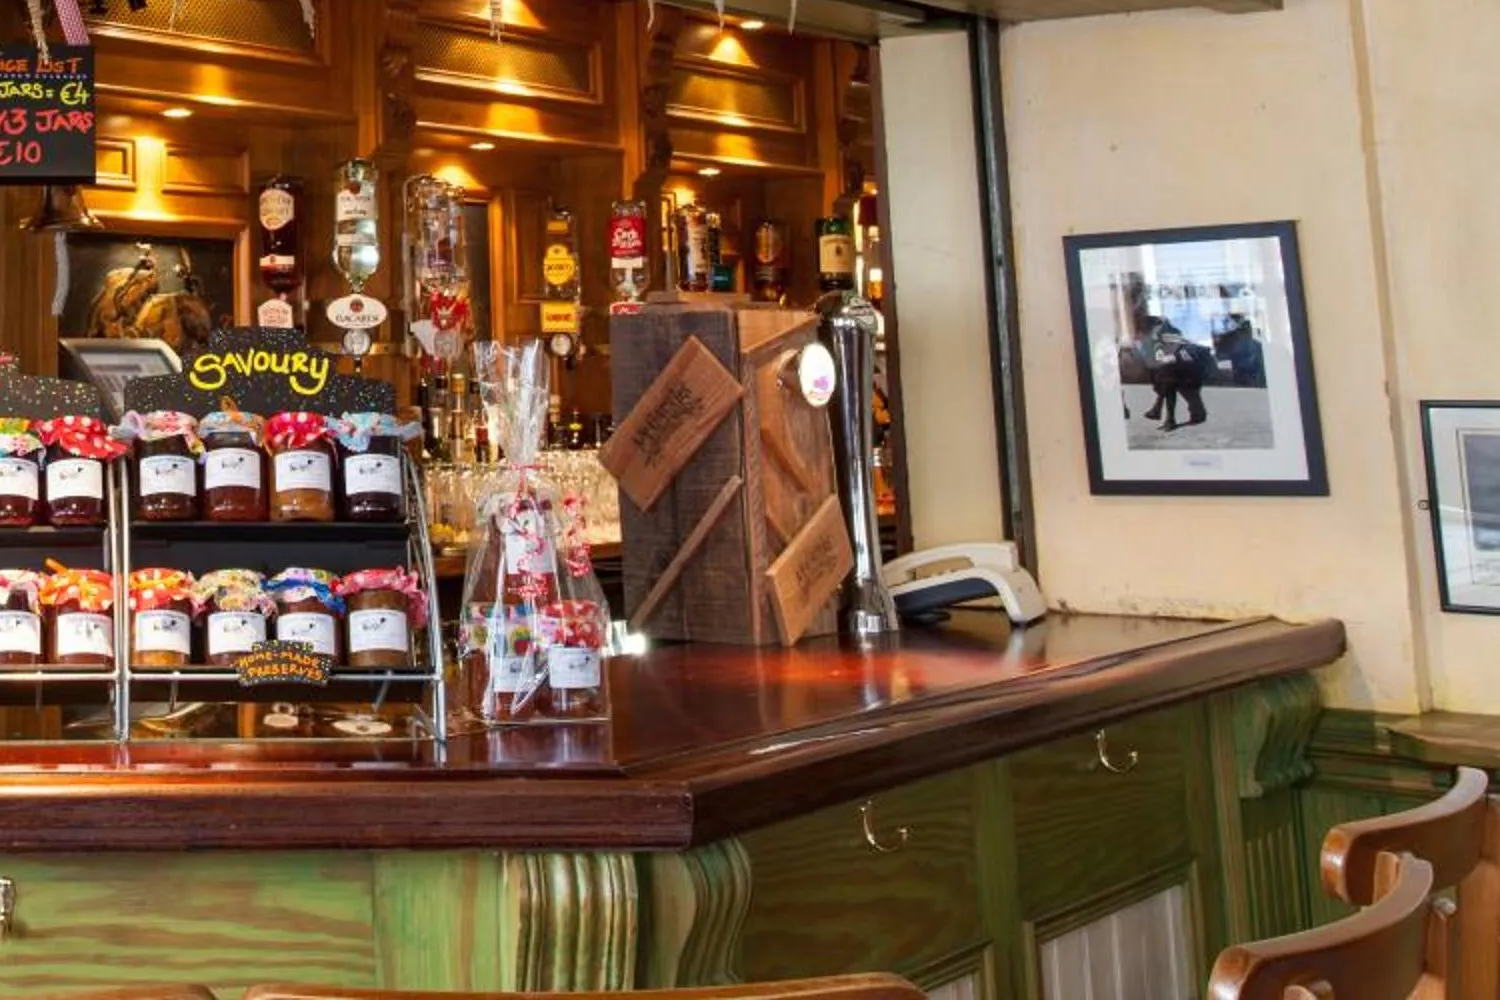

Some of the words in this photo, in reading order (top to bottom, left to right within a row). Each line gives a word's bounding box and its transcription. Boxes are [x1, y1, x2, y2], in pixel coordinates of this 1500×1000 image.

[60, 81, 91, 105] €4
[3, 108, 28, 135] 3
[35, 109, 94, 133] JARS
[188, 348, 330, 396] SAVOURY
